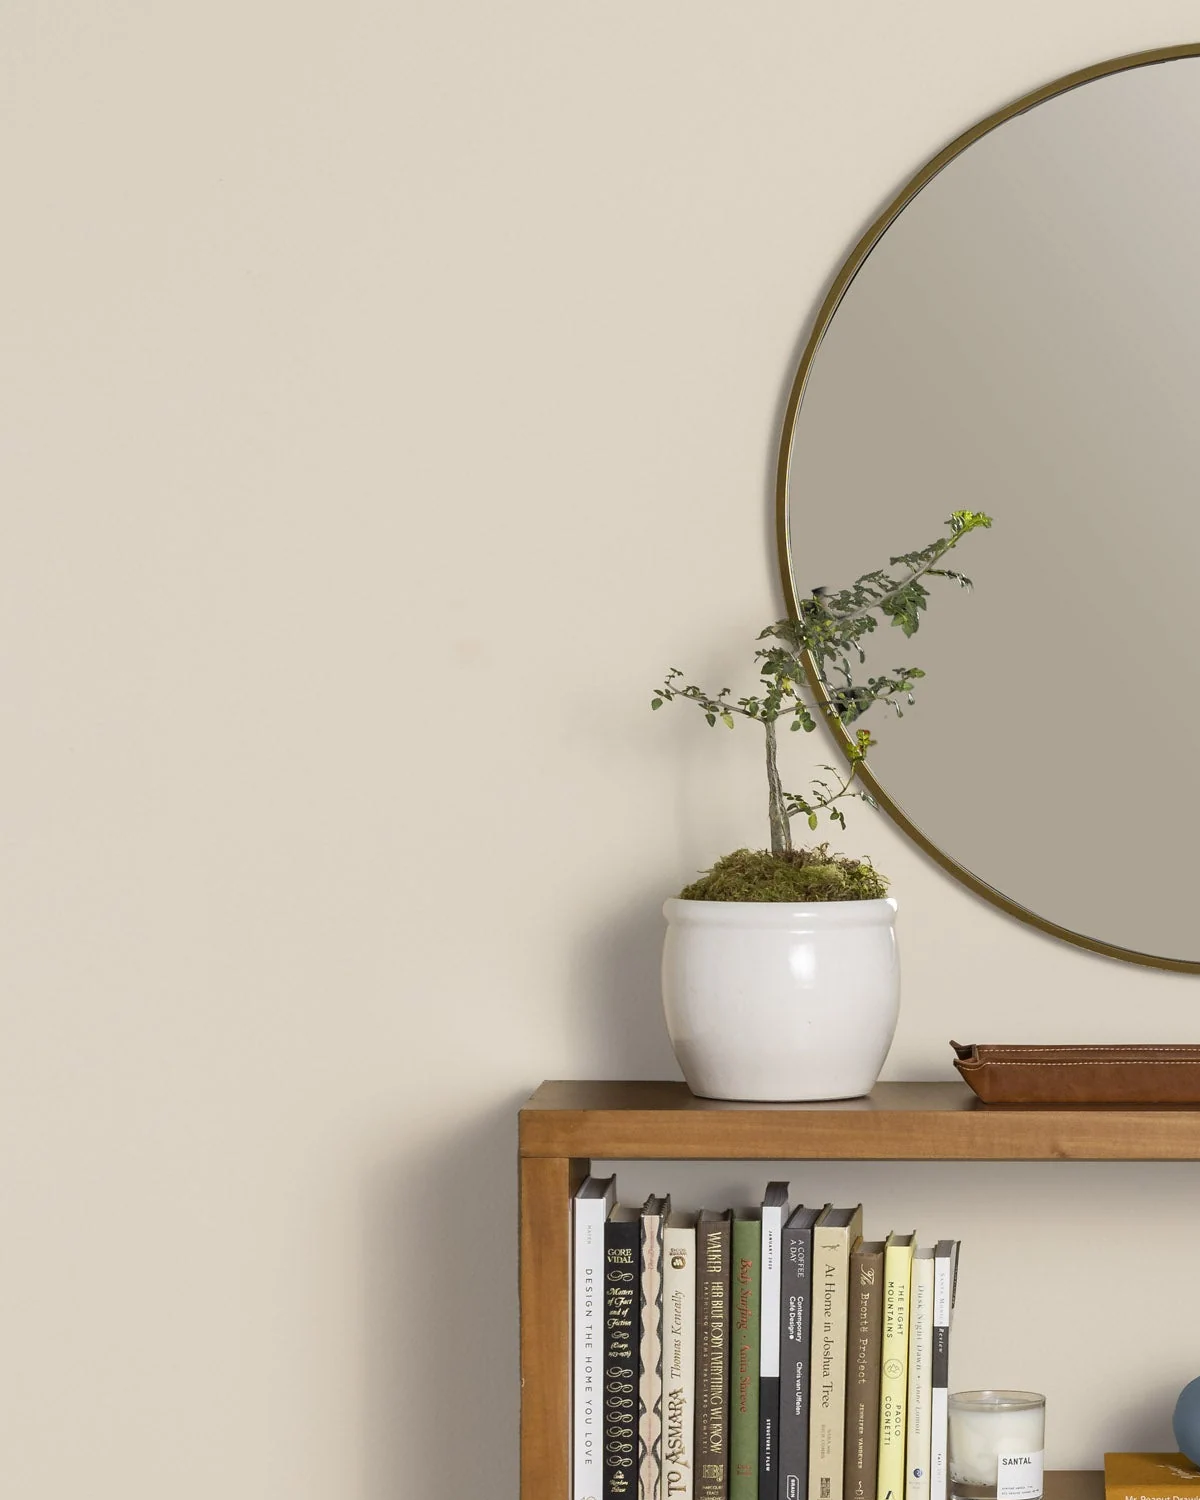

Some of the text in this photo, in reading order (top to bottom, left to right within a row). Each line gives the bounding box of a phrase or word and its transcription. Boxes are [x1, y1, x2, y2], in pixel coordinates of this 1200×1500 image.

[607, 1256, 634, 1264] VIDAL
[608, 1248, 632, 1256] GORE
[706, 1231, 722, 1273] WALKER
[790, 1247, 798, 1263] DAY
[797, 1247, 805, 1278] COFFEE
[788, 1296, 798, 1335] Café Design
[886, 1281, 894, 1338] MOUNTAINS
[917, 1285, 925, 1309] Dusk
[671, 1290, 685, 1379] Thomas Keneally
[736, 1258, 754, 1413] Body Surfing Anita Shreve
[795, 1296, 804, 1343] Contemporary
[821, 1263, 836, 1408] At Home in Joshua Tree
[857, 1263, 875, 1384] The Brontë Project
[896, 1306, 904, 1335] EIGHT
[914, 1313, 924, 1340] Night
[585, 1268, 593, 1465] DESIGN THE HOME YOU LOVE
[710, 1281, 724, 1454] HER BLUE BODY EVERYTHING WE KNOW
[795, 1361, 803, 1380] Chris
[795, 1391, 803, 1416] Uffelen
[884, 1395, 892, 1446] COGNETTI
[894, 1405, 902, 1437] PAOLO
[665, 1387, 691, 1497] TO ASMARA
[1002, 1457, 1032, 1466] SANTAL
